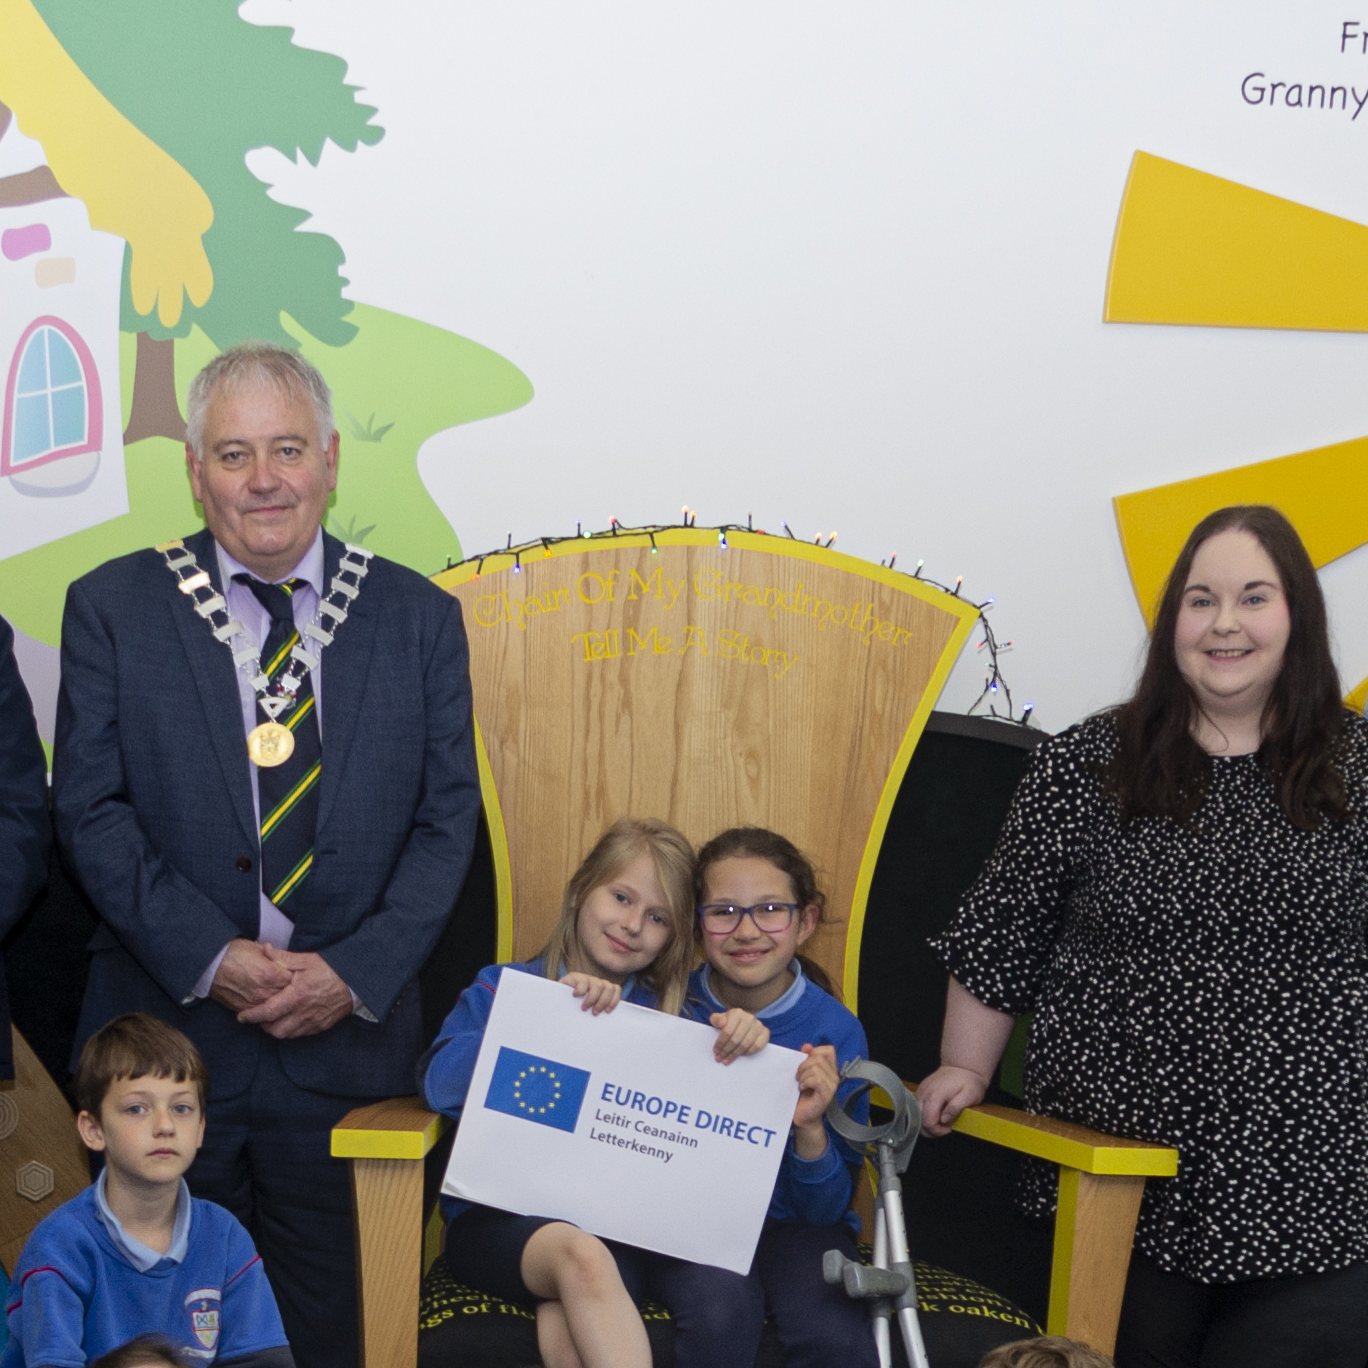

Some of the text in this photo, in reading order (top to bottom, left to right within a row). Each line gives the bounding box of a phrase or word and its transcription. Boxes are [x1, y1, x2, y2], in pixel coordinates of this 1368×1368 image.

[474, 567, 914, 647] Chair Of My Grandmother
[570, 624, 800, 679] Tell Me A Story
[594, 1108, 699, 1149] Leitir Ceanainn
[600, 1081, 777, 1149] EUROPE DIRECT
[589, 1127, 674, 1164] Letterkenny
[462, 1302, 491, 1315] of
[948, 1303, 1031, 1330] oaken
